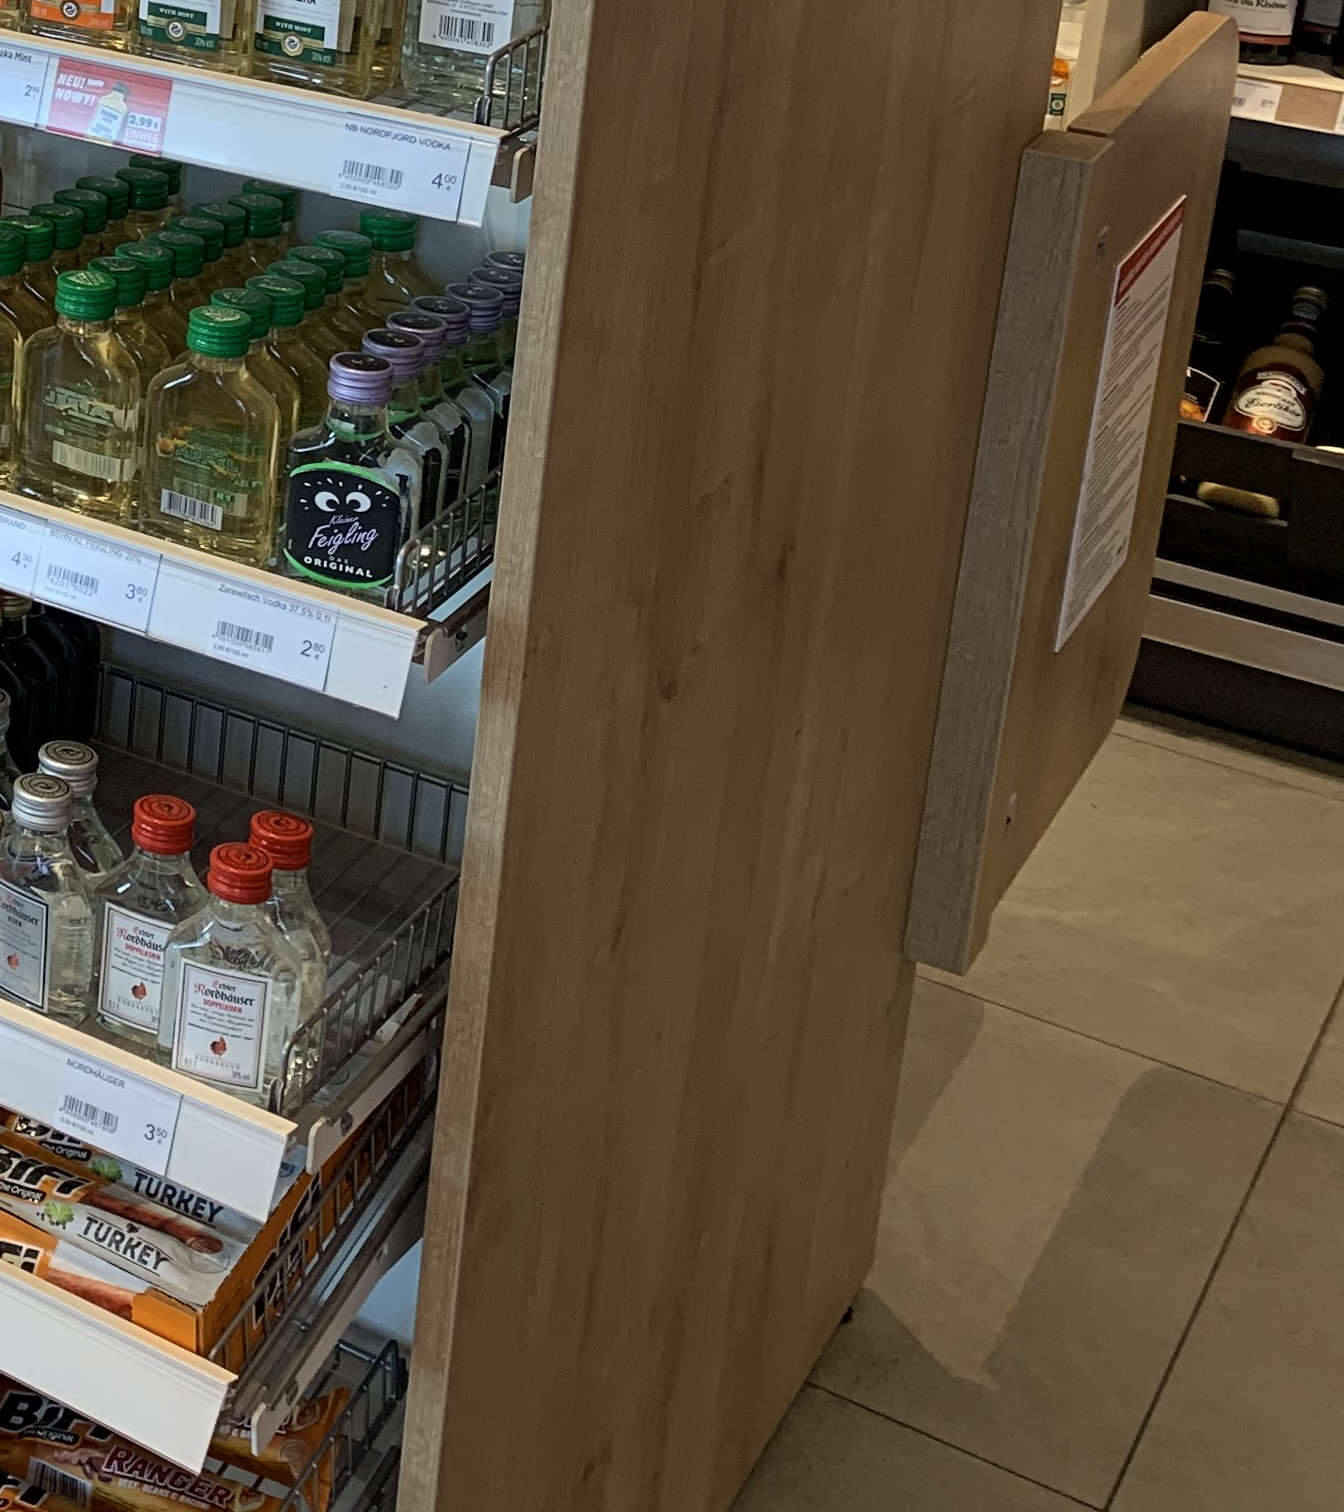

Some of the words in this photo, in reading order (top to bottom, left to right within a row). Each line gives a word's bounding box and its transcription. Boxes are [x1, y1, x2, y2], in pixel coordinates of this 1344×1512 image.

[56, 71, 86, 89] NEU!
[54, 87, 96, 106] NOWY!
[345, 123, 358, 132] NB
[360, 126, 416, 145] NORDFJORD
[419, 139, 451, 151] VODKA
[308, 520, 379, 554] Feigling
[302, 556, 373, 580] ORIGINAL
[189, 983, 257, 1008] Nordhäuser
[66, 1057, 127, 1090] NORDHÄUSER
[132, 1170, 225, 1224] TURKEY
[102, 1443, 234, 1511] RANGER
